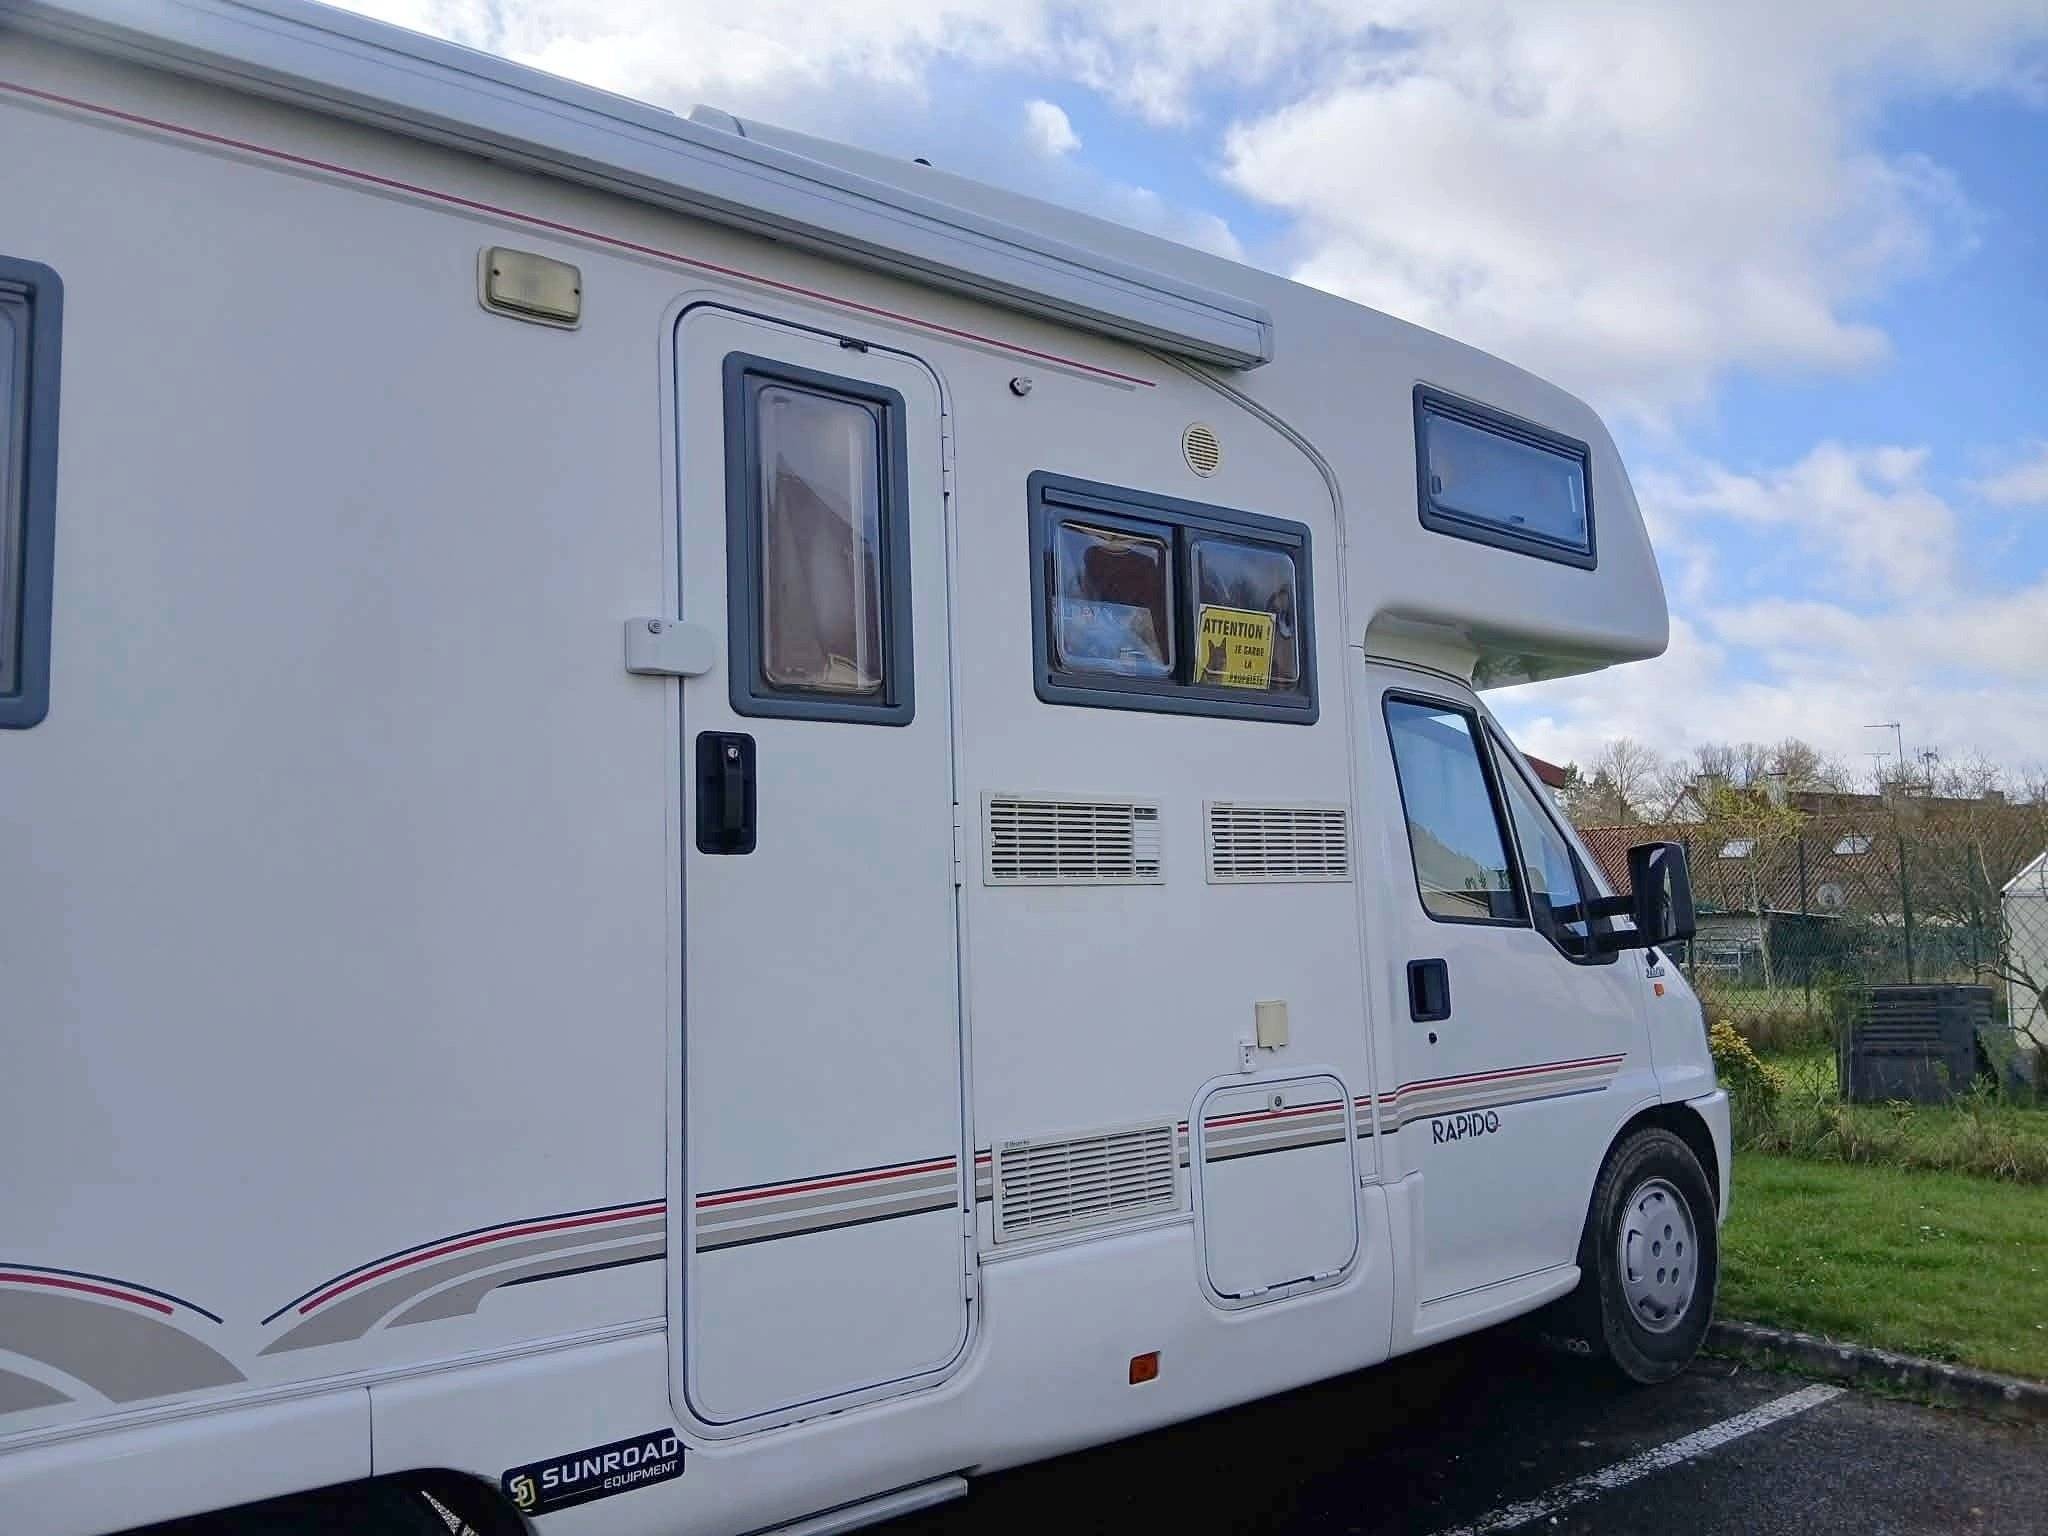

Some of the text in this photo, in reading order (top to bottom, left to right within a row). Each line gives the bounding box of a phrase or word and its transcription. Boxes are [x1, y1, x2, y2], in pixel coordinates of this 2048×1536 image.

[1203, 618, 1271, 640] ATTENTION !
[1234, 644, 1264, 657] JE GARDE
[1244, 660, 1252, 669] LA
[1432, 1110, 1501, 1144] RAPIDO
[542, 1436, 678, 1489] SUNROAD
[604, 1460, 678, 1489] EQUIPMENT
